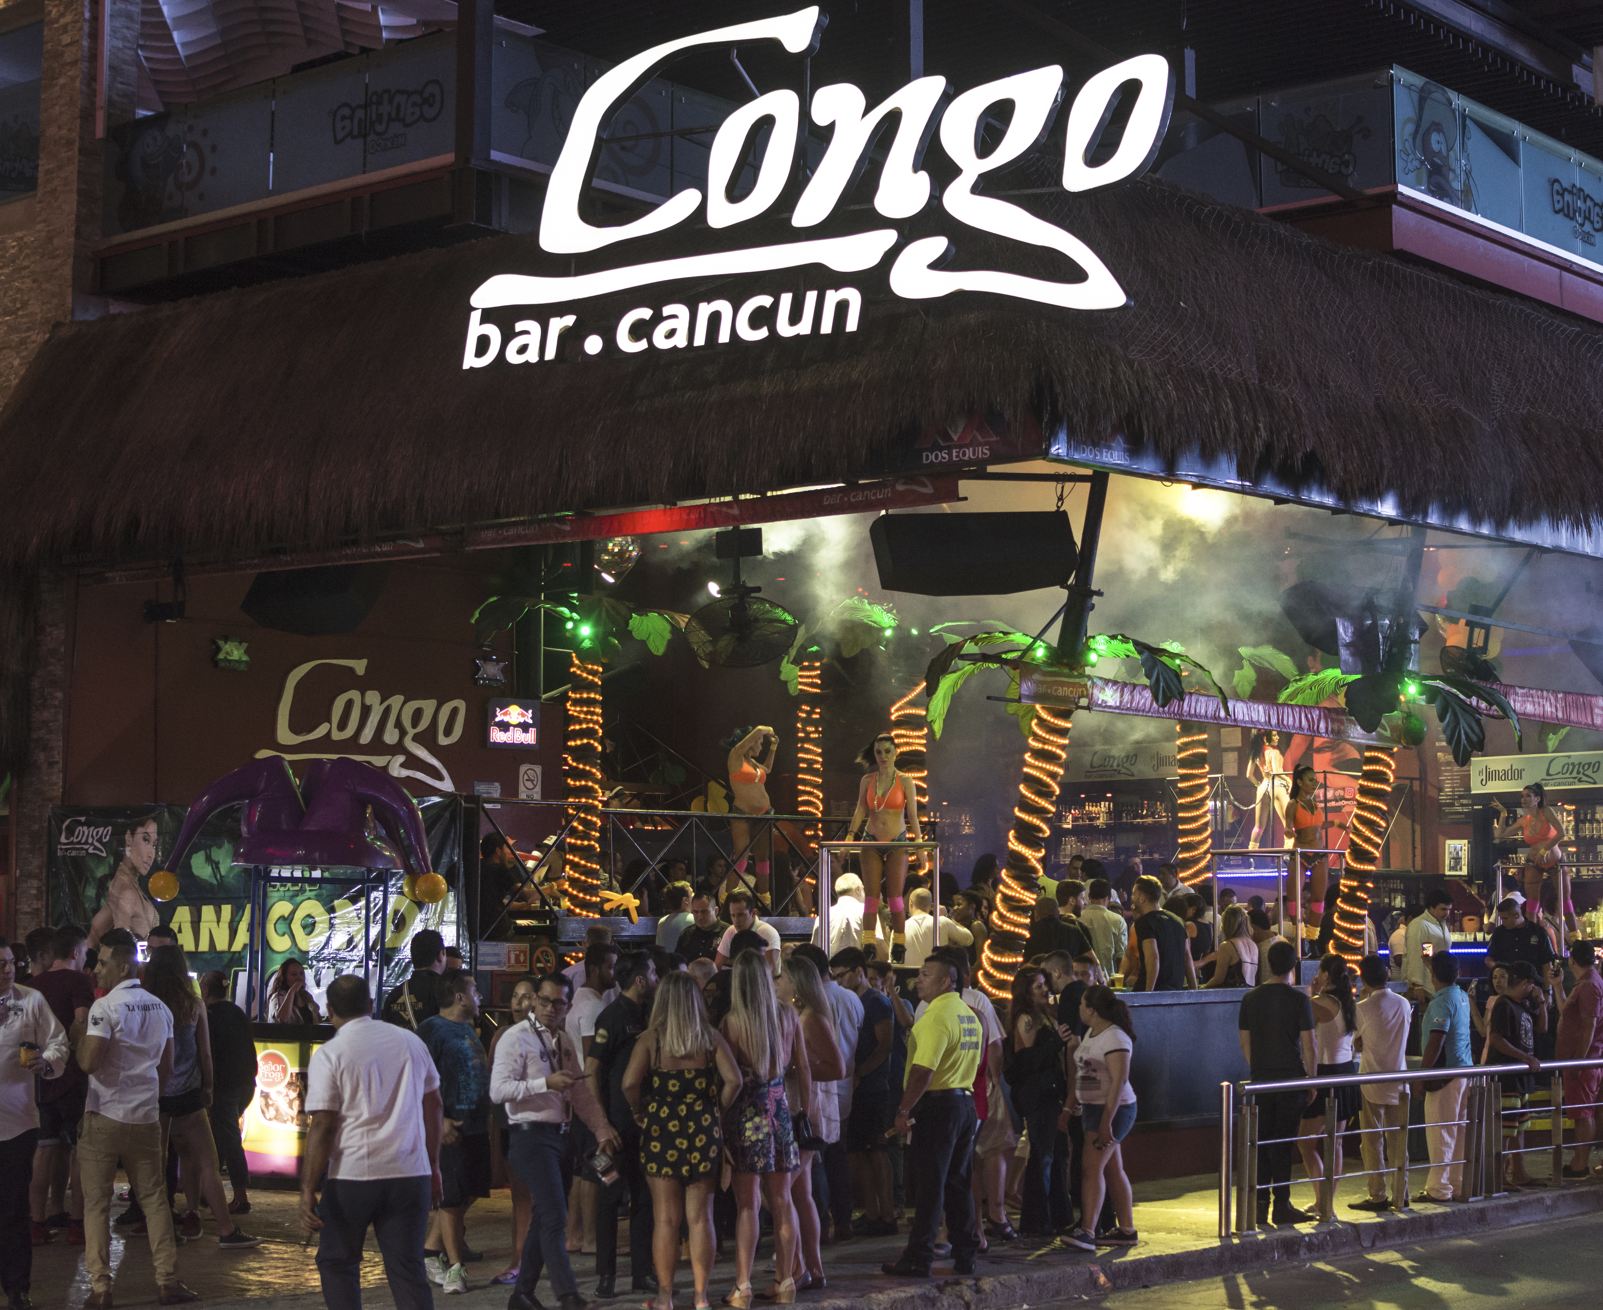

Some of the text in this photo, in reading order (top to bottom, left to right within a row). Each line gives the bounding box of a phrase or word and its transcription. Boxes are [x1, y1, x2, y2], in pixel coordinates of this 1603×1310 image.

[540, 6, 1169, 309] Congo
[922, 445, 991, 464] DOS EQUIS
[277, 659, 466, 793] Congo
[490, 726, 537, 745] Red Bull
[1090, 751, 1138, 777] Congo
[1152, 751, 1179, 772] Jima
[1546, 755, 1601, 785] Congo
[1480, 764, 1526, 786] Jimador
[60, 816, 113, 857] Congo
